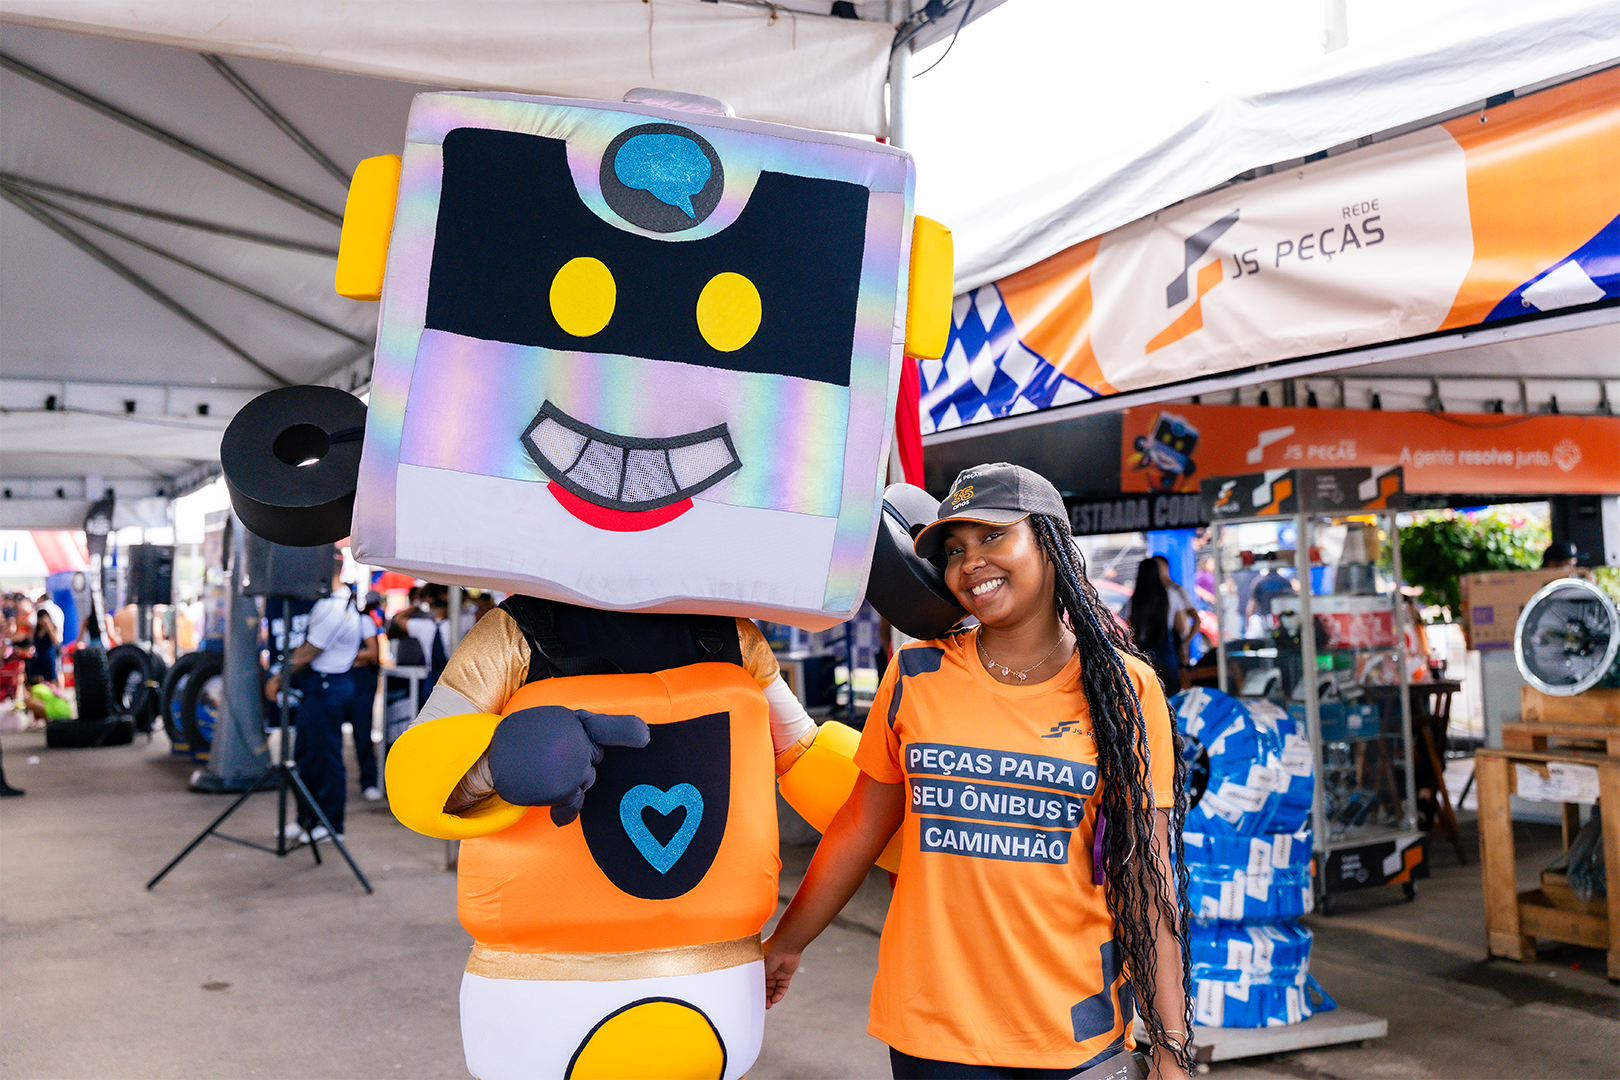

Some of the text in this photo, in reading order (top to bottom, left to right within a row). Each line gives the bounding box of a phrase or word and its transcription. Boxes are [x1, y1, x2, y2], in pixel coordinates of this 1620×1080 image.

[1342, 198, 1380, 220] REDE
[1232, 215, 1385, 279] JS PEÇAS
[1400, 446, 1412, 464] A
[1413, 449, 1456, 469] gente
[1458, 446, 1514, 466] resolve
[951, 485, 974, 505] 35
[952, 500, 970, 510] anos
[1072, 498, 1150, 534] ESTRADA
[1071, 727, 1083, 736] JS
[910, 748, 1097, 790] PEÇAS PARA O
[913, 784, 1081, 821] SEU ÔNIBUS E
[925, 827, 1064, 860] CAMINHÃO
